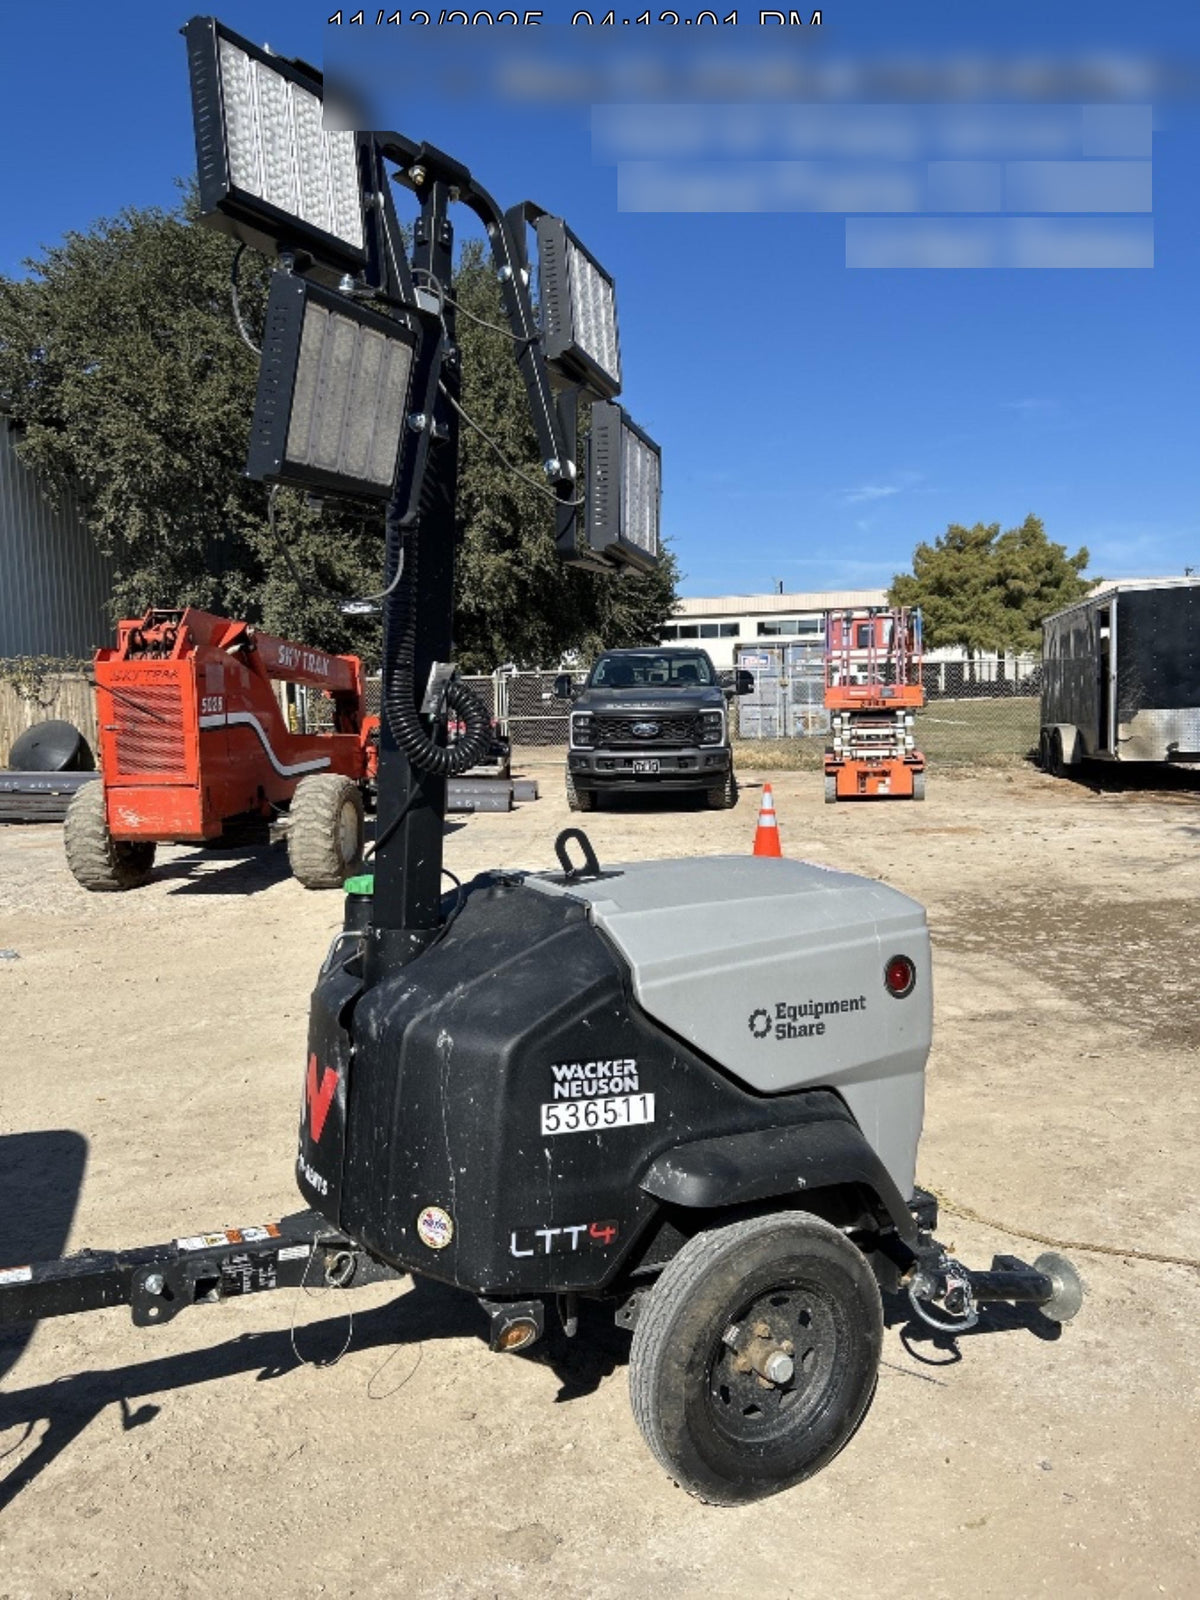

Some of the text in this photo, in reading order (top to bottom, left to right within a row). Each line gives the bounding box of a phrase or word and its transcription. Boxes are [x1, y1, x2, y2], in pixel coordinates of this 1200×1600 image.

[775, 995, 867, 1022] Equipment
[775, 1021, 826, 1041] Share
[551, 1058, 639, 1082] WACKER
[553, 1075, 639, 1100] NEUSON
[545, 1094, 648, 1132] 536511
